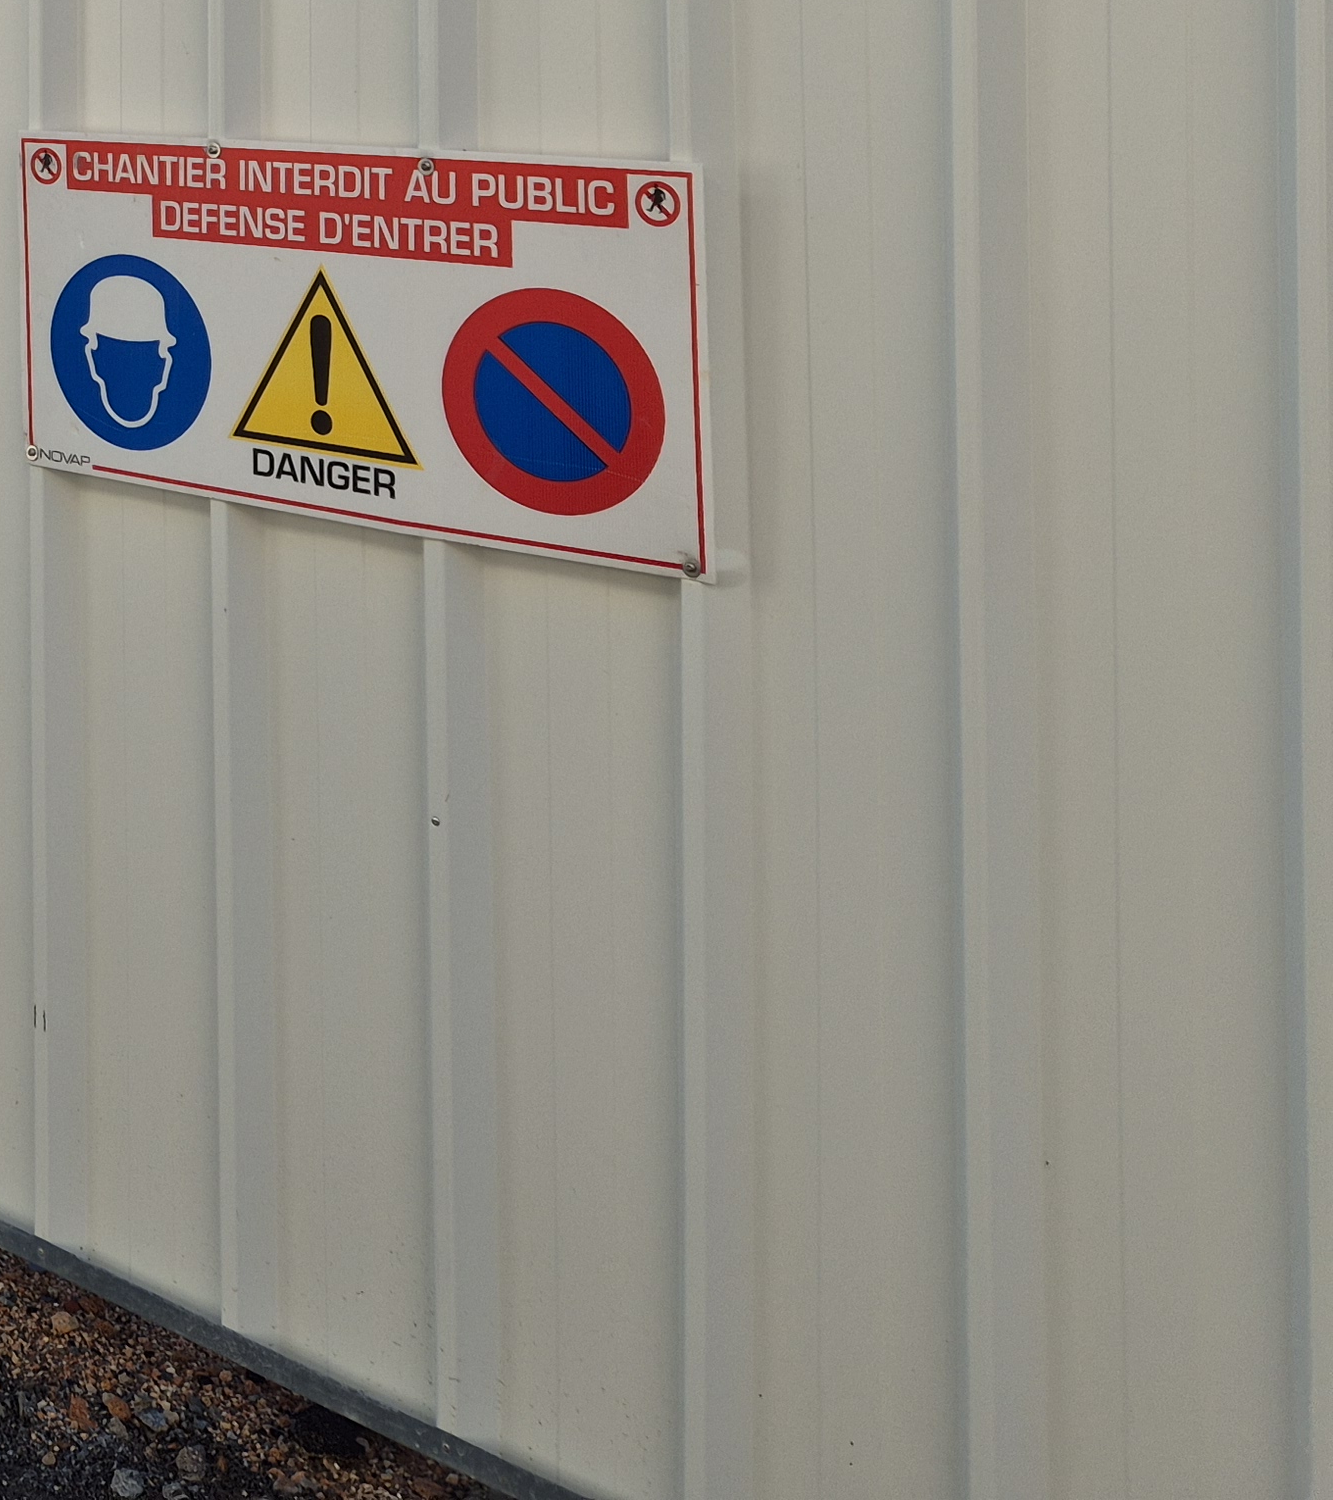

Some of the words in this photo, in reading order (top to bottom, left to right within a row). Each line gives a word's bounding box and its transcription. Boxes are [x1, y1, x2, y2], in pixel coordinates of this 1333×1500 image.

[72, 151, 226, 190] CHANTIER
[239, 159, 393, 201] INTERDIT
[404, 168, 456, 206] AU
[471, 172, 615, 217] PUBLIC
[159, 200, 306, 242] DEFENSE
[318, 211, 499, 258] D'ENTRER
[39, 448, 91, 467] NOVAP
[252, 448, 396, 500] DANGER
